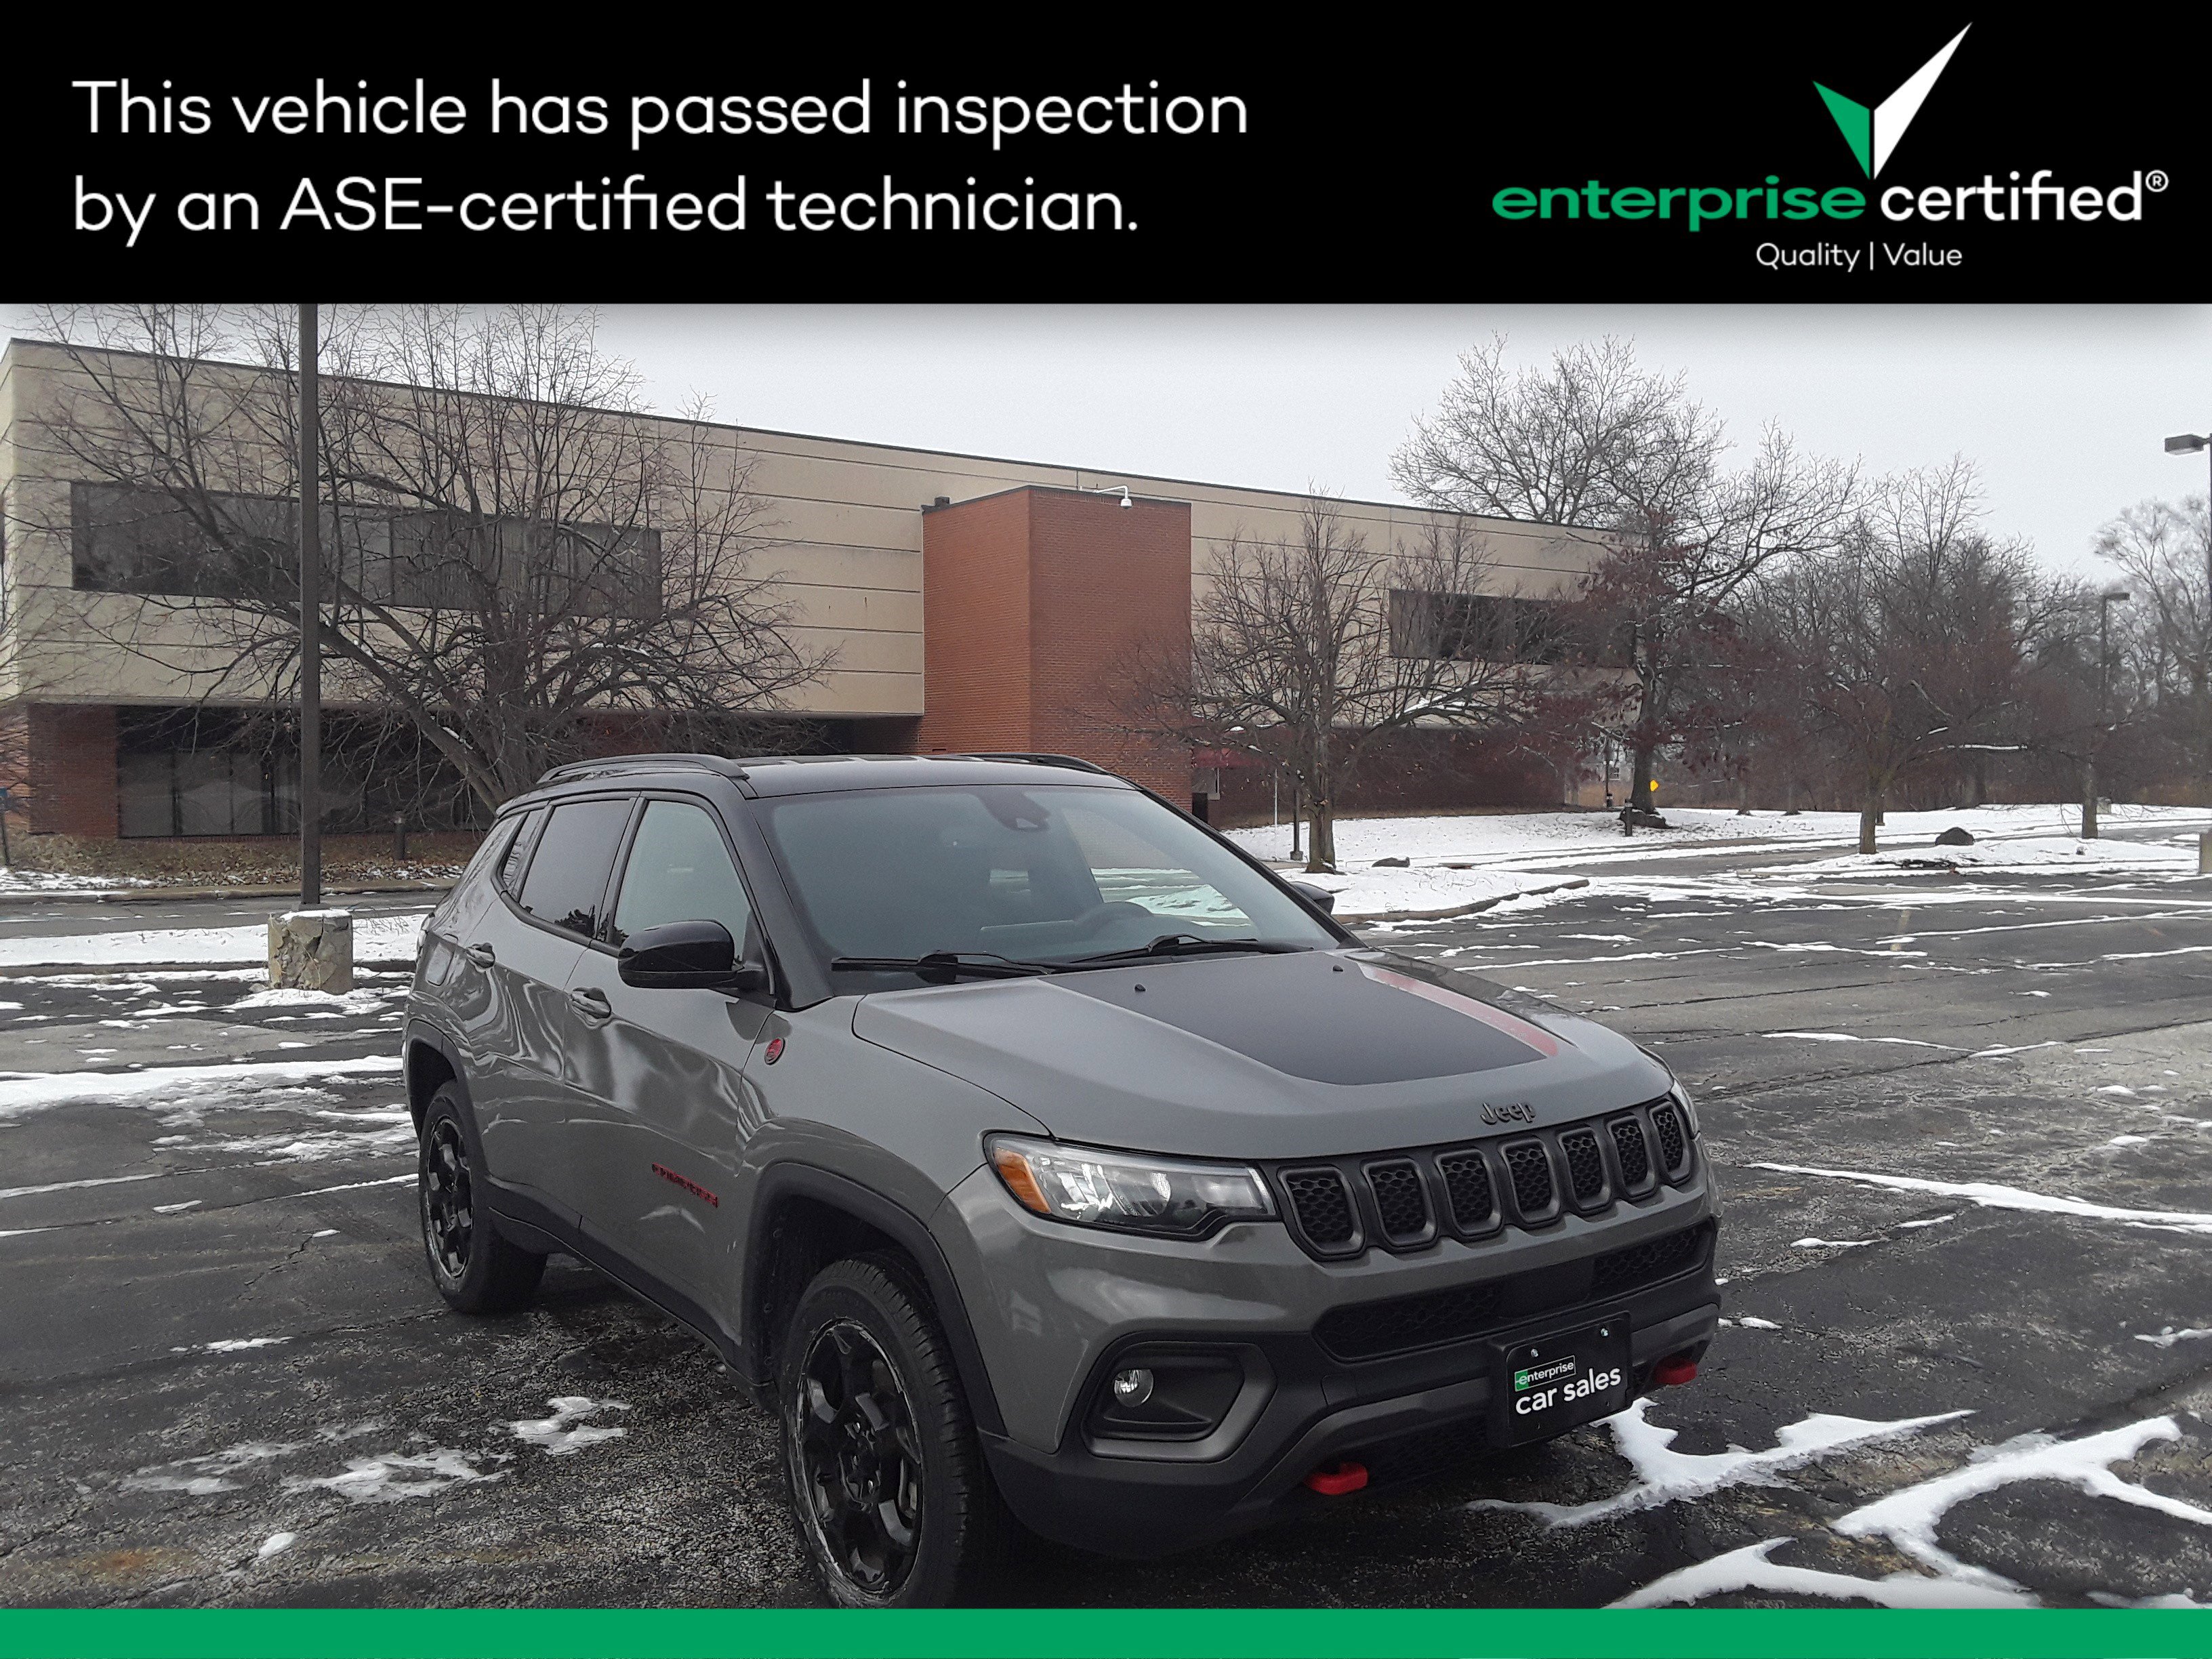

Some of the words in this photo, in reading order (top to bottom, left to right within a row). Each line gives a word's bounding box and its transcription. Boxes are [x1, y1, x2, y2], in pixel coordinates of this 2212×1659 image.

[1480, 1102, 1536, 1126] Jeep
[1515, 1360, 1574, 1386] enterprise
[1515, 1387, 1558, 1415] car
[1563, 1368, 1622, 1402] sales
